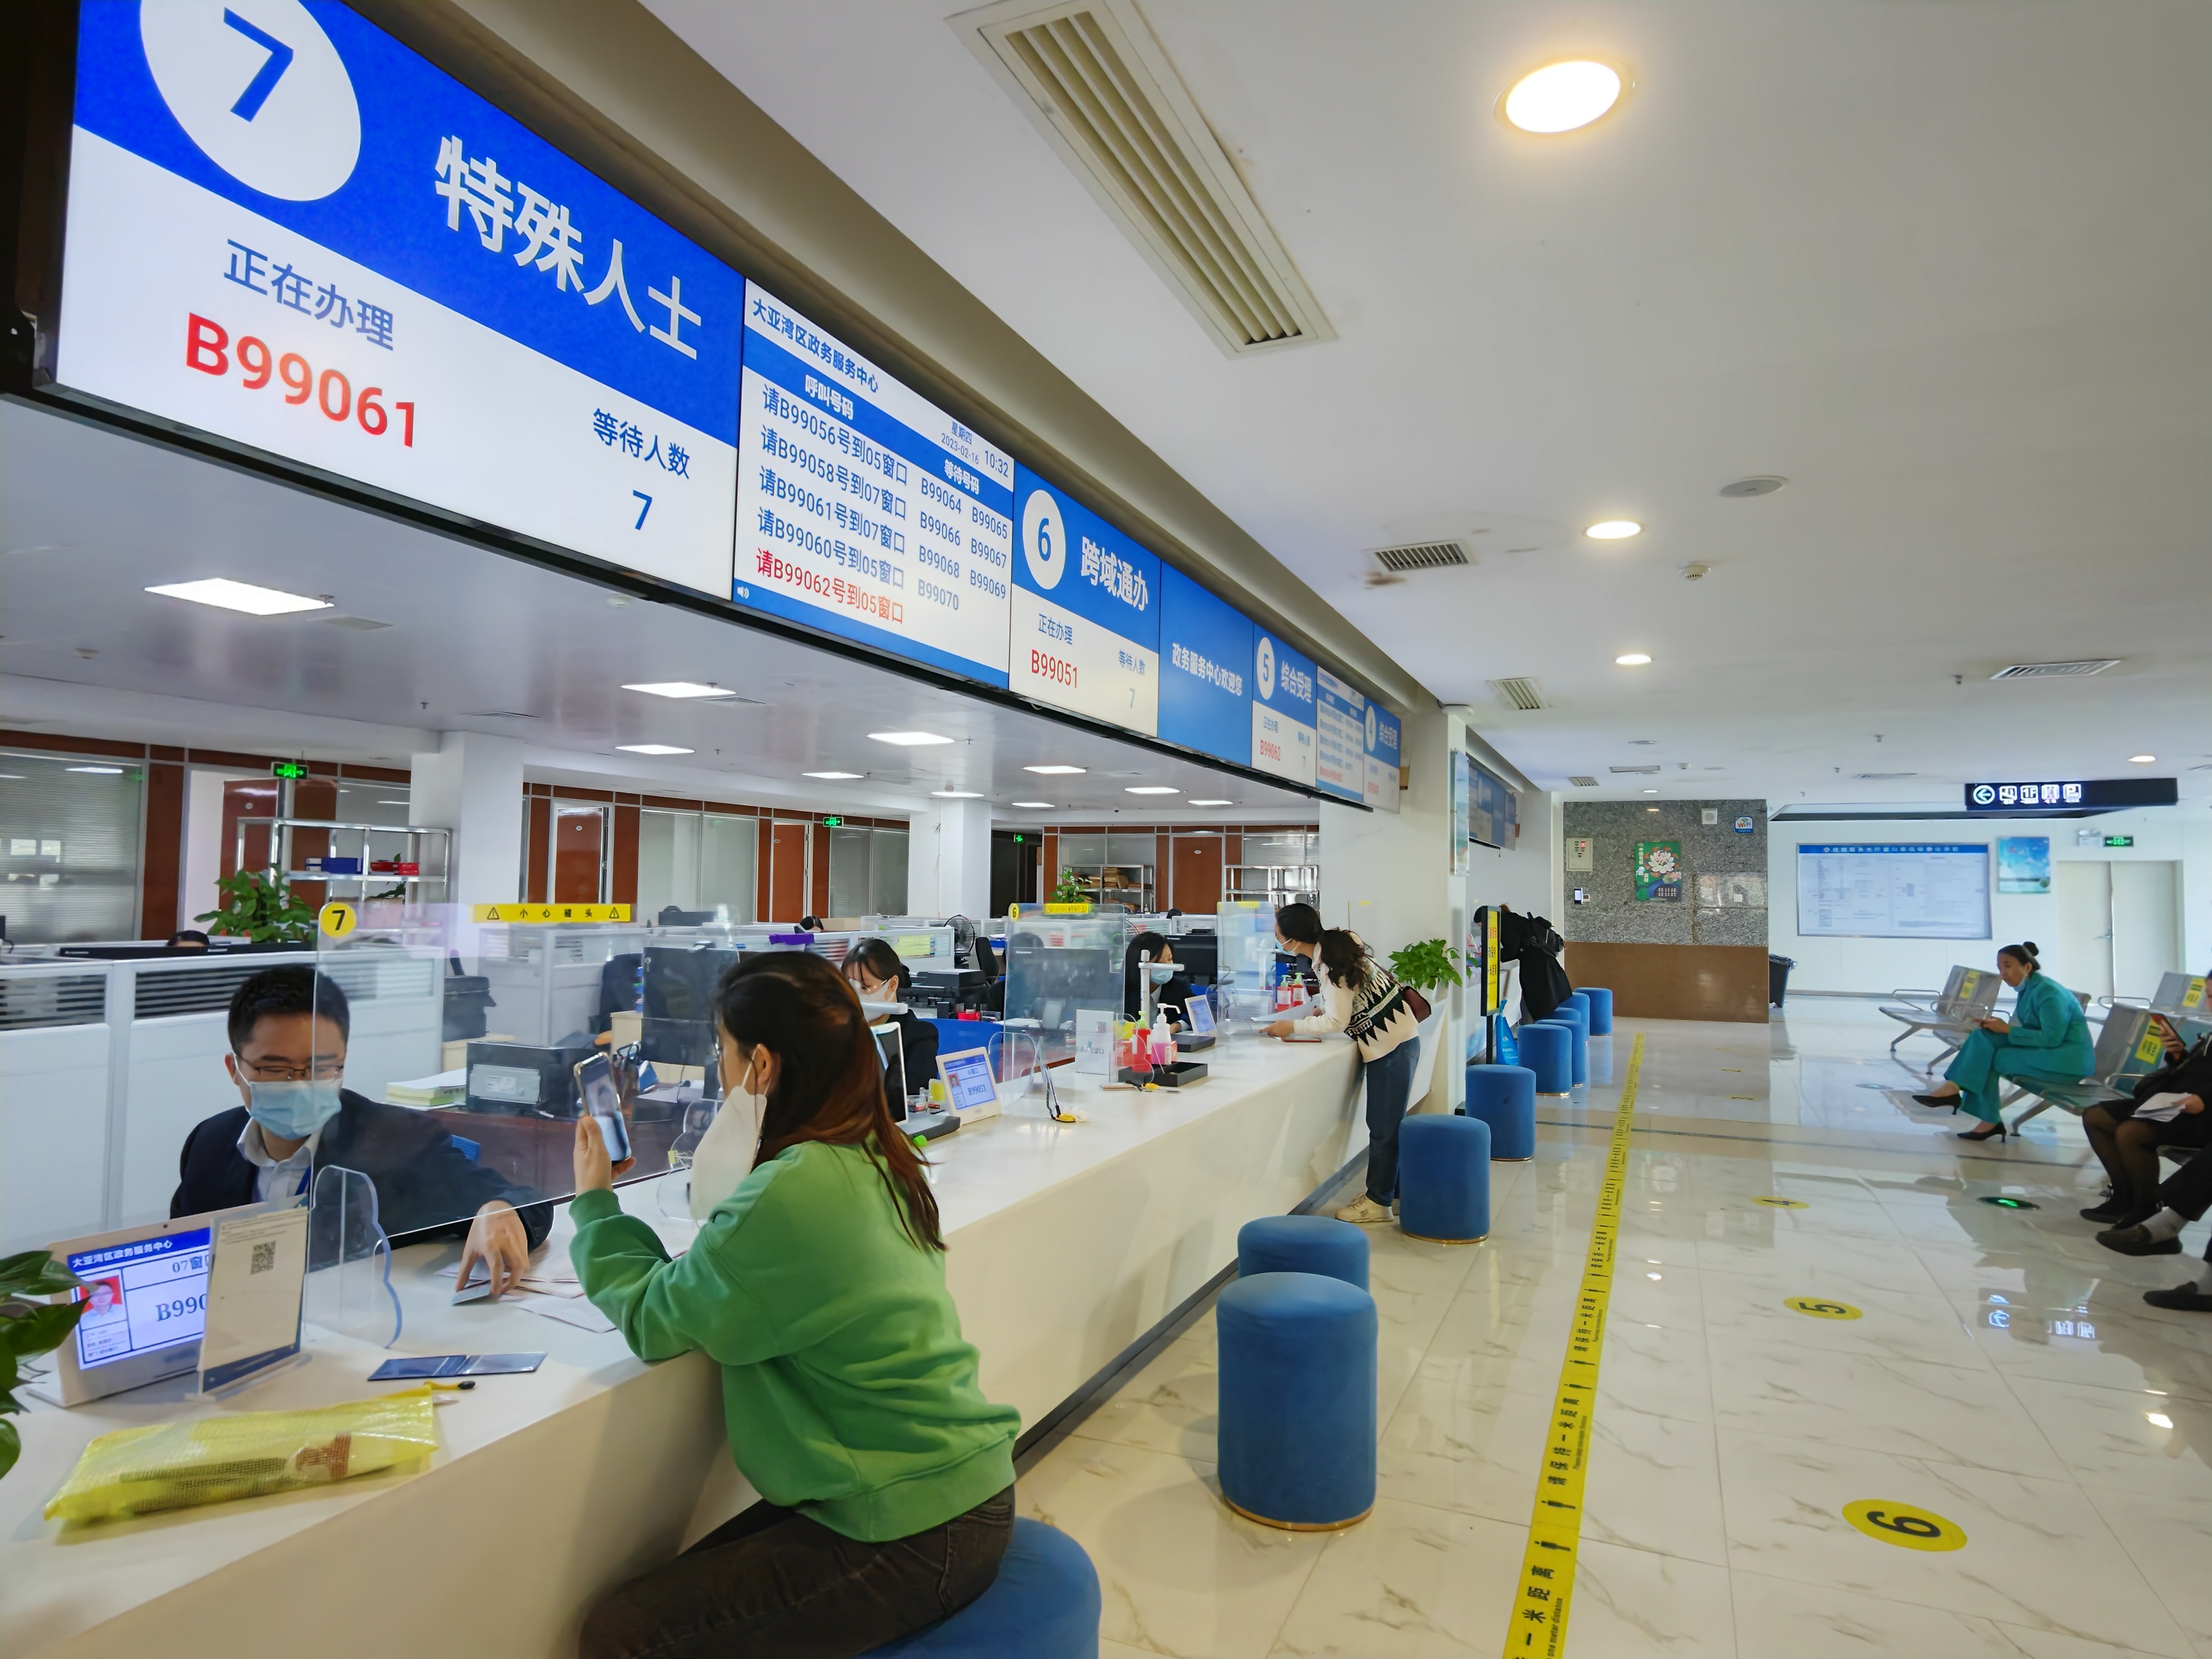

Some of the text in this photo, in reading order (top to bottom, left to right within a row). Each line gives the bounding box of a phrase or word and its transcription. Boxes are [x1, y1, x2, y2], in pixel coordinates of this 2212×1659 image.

[224, 7, 294, 123] 7
[435, 134, 702, 360] 特殊人士
[224, 238, 394, 350] 正在办理
[753, 299, 879, 393] 大亚湾区政务服务中心
[186, 312, 415, 448] B99061
[805, 375, 854, 421] 呼叫号码
[593, 408, 690, 480] 等待人数
[763, 385, 907, 486] 请B99056号到05窗口
[941, 434, 979, 465] 2023-02-16
[951, 421, 973, 445] 星期四
[761, 425, 906, 520] 请B99058号到07窗口
[944, 460, 979, 495] 等待号码
[984, 449, 1009, 478] 10:32
[632, 490, 652, 530] 7
[759, 466, 905, 554] 请B99061号到07窗口
[921, 477, 1008, 539] B99064 B99065
[757, 506, 904, 590] 请B99060号到05窗口
[920, 512, 1007, 569] B99066 B99067
[1037, 517, 1052, 562] 6
[756, 548, 903, 624] 请B99062号到05窗口
[918, 579, 959, 610] B99070
[919, 545, 1006, 599] B99068 B99069
[1081, 536, 1148, 611] 跨域通办
[1038, 613, 1073, 645] 正在办理
[1031, 649, 1078, 689] B99051
[1118, 650, 1146, 677] 等待人数
[1172, 643, 1242, 697] 政务服务中心欢迎您
[1263, 653, 1269, 682] 5
[1280, 660, 1312, 704] 综合受理
[1129, 689, 1135, 709] 7
[1260, 739, 1280, 761] B99062
[2023, 787, 2036, 798] 1F
[331, 910, 346, 930] 7
[1013, 907, 1016, 918] 6
[968, 1084, 987, 1095] B99051
[72, 1240, 172, 1267] 大亚湾区政务服务中心
[1799, 1300, 1846, 1315] 5
[1547, 1398, 1580, 1486] 请保持一米距离
[1866, 1510, 1941, 1539] 6
[1512, 1565, 1555, 1659] 一米距离
[1547, 1597, 1563, 1657] one meter distance
